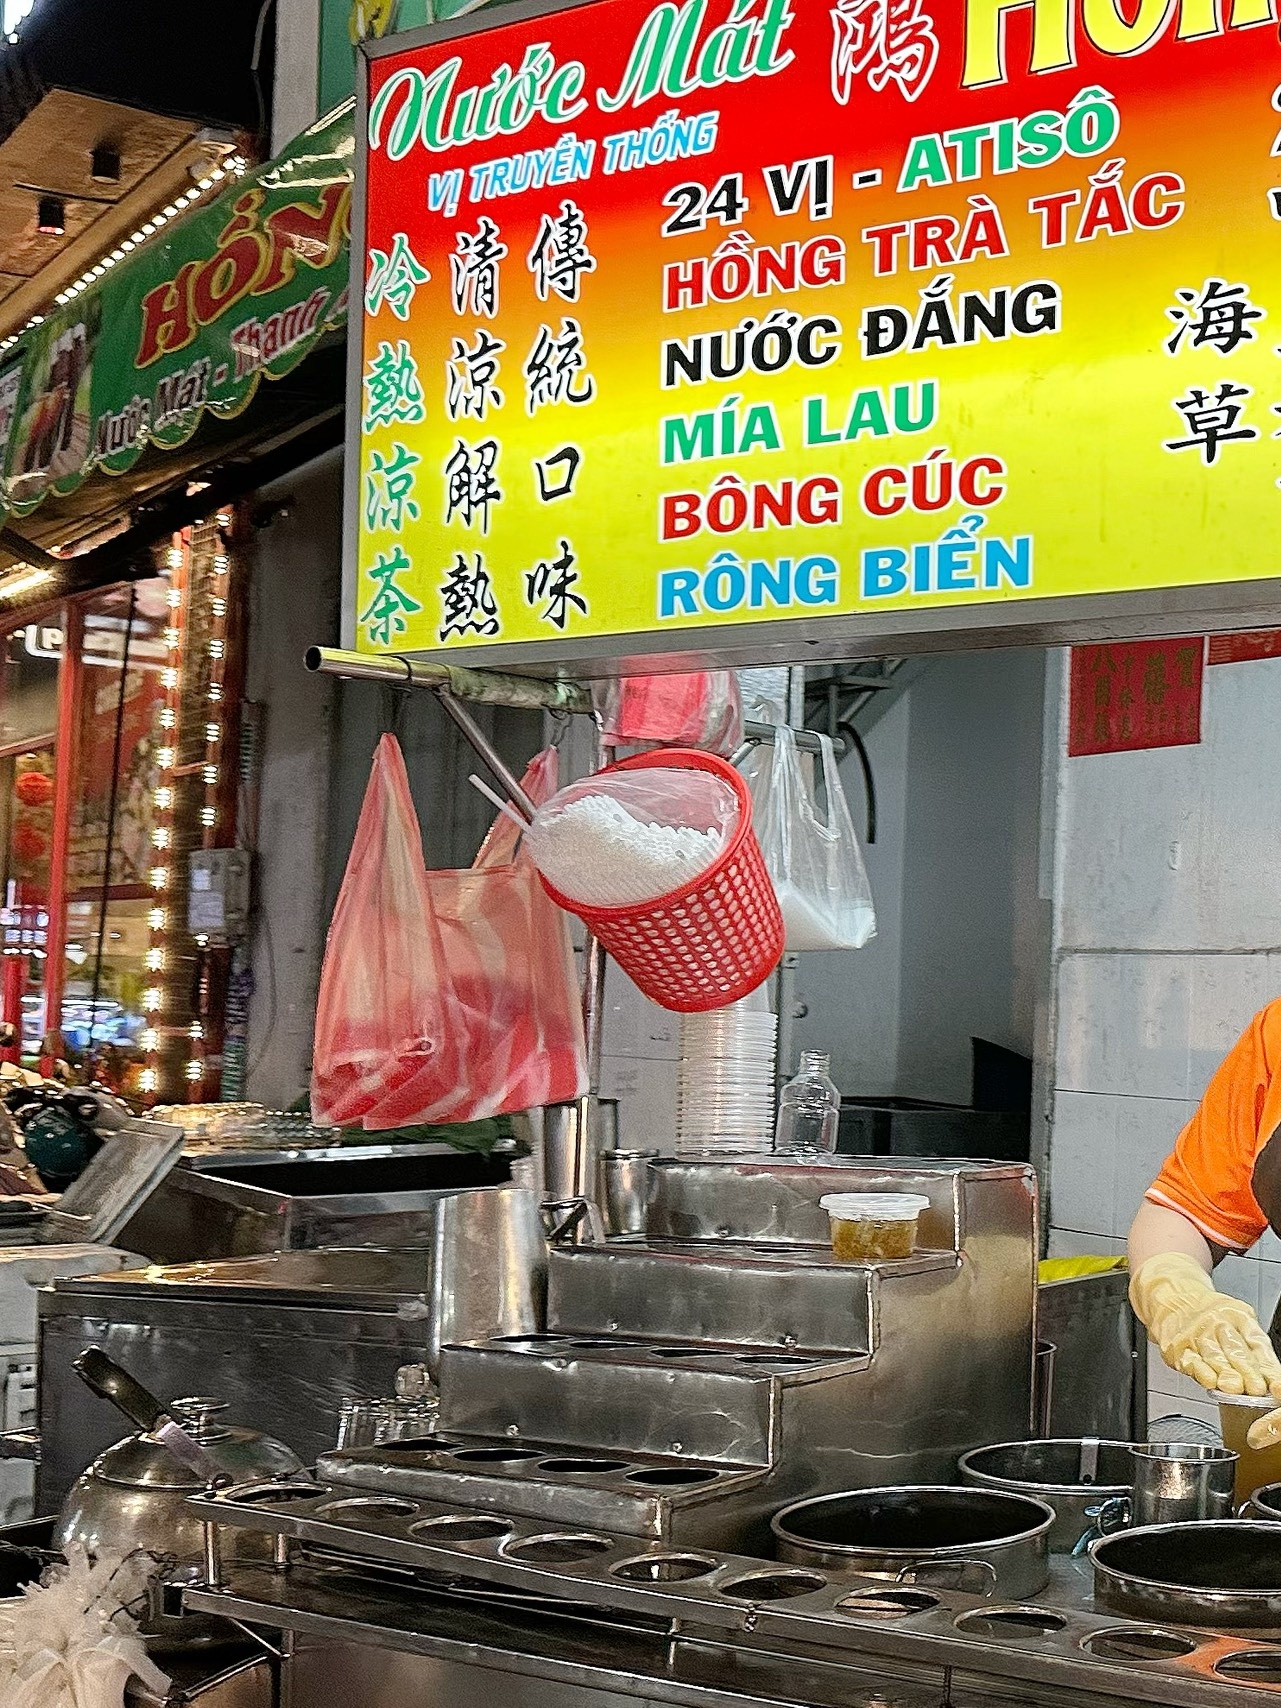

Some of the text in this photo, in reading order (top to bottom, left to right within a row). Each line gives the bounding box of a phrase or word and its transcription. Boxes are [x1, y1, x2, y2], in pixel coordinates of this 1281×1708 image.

[370, 0, 797, 161] Nước Mát
[427, 109, 720, 214] VỊ TRUYỀN THỐNG
[661, 86, 1121, 236] 24 VỊ - ATISÔ
[661, 159, 1186, 313] HỒNG TRÀ TẮC
[661, 275, 1062, 389] NƯỚC ĐẮNG
[1163, 276, 1267, 464] 海草
[360, 234, 431, 646] 冷熱涼茶
[437, 215, 508, 642] 清涼解熱
[523, 202, 597, 630] 傳統口味
[660, 378, 940, 465] MÍA LAU
[658, 513, 1035, 618] RÔNG BIỂN
[659, 447, 1008, 542] BÔNG CÚC
